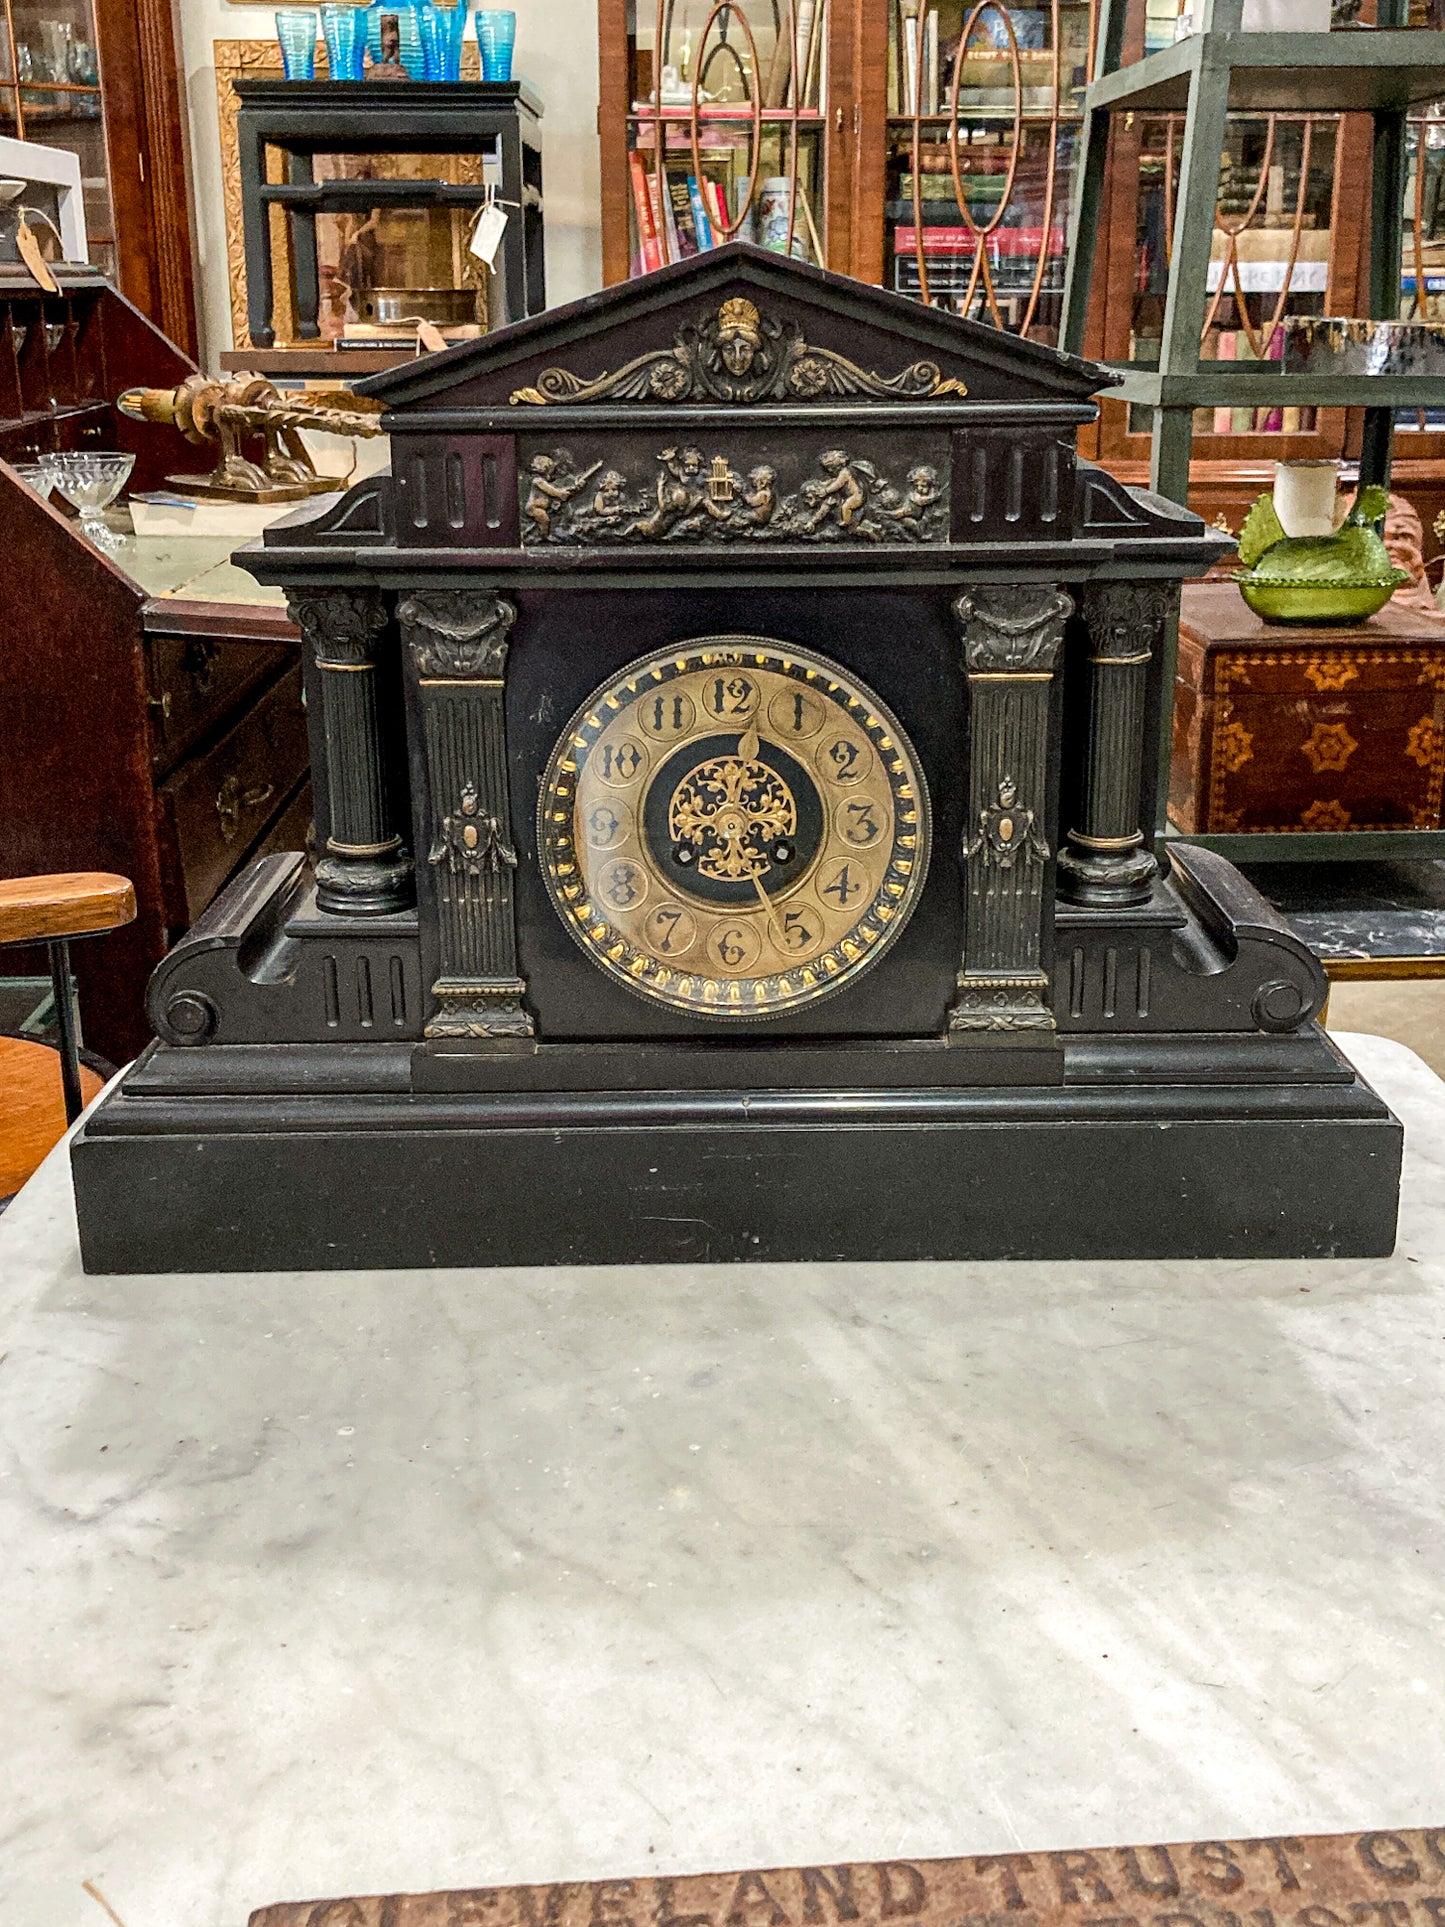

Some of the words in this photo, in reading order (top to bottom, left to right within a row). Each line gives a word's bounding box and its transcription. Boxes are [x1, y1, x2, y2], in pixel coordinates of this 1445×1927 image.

[652, 695, 683, 731] 11
[713, 677, 752, 714] 12
[792, 693, 804, 731] 1
[603, 743, 642, 778] 10
[828, 740, 860, 779] 2
[588, 806, 619, 842] 9
[846, 803, 881, 841] 3
[608, 868, 637, 905] 8
[822, 864, 860, 904] 4
[656, 911, 682, 951] 7
[717, 930, 746, 965] 6
[785, 910, 812, 949] 5
[974, 1834, 1304, 1910] TRUST
